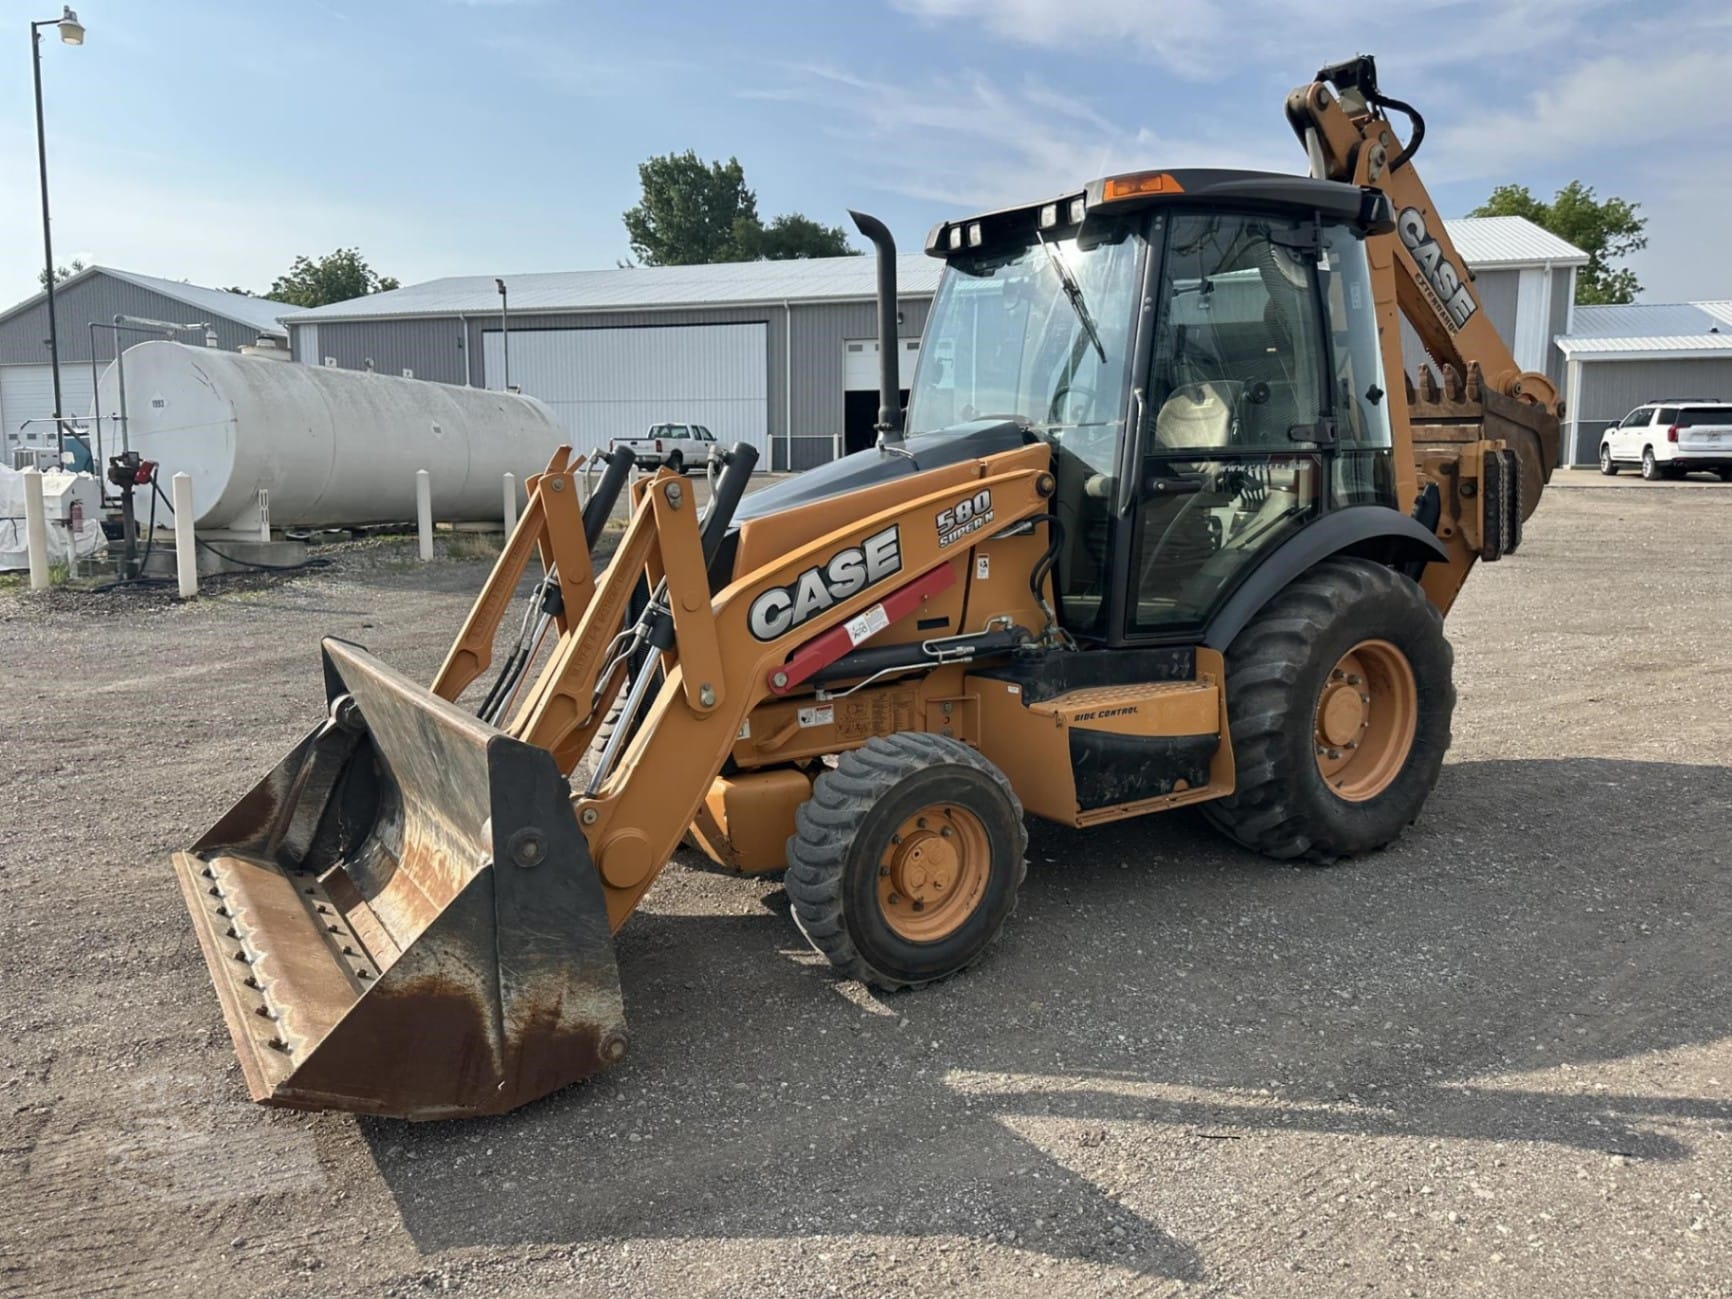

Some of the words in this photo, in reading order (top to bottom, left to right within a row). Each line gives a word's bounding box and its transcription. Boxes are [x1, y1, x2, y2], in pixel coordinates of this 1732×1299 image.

[1399, 207, 1478, 329] CASE
[936, 488, 992, 536] 580
[939, 516, 984, 548] SUPER
[984, 509, 995, 524] N
[748, 523, 903, 642] CASE
[1098, 706, 1139, 719] CONTROL
